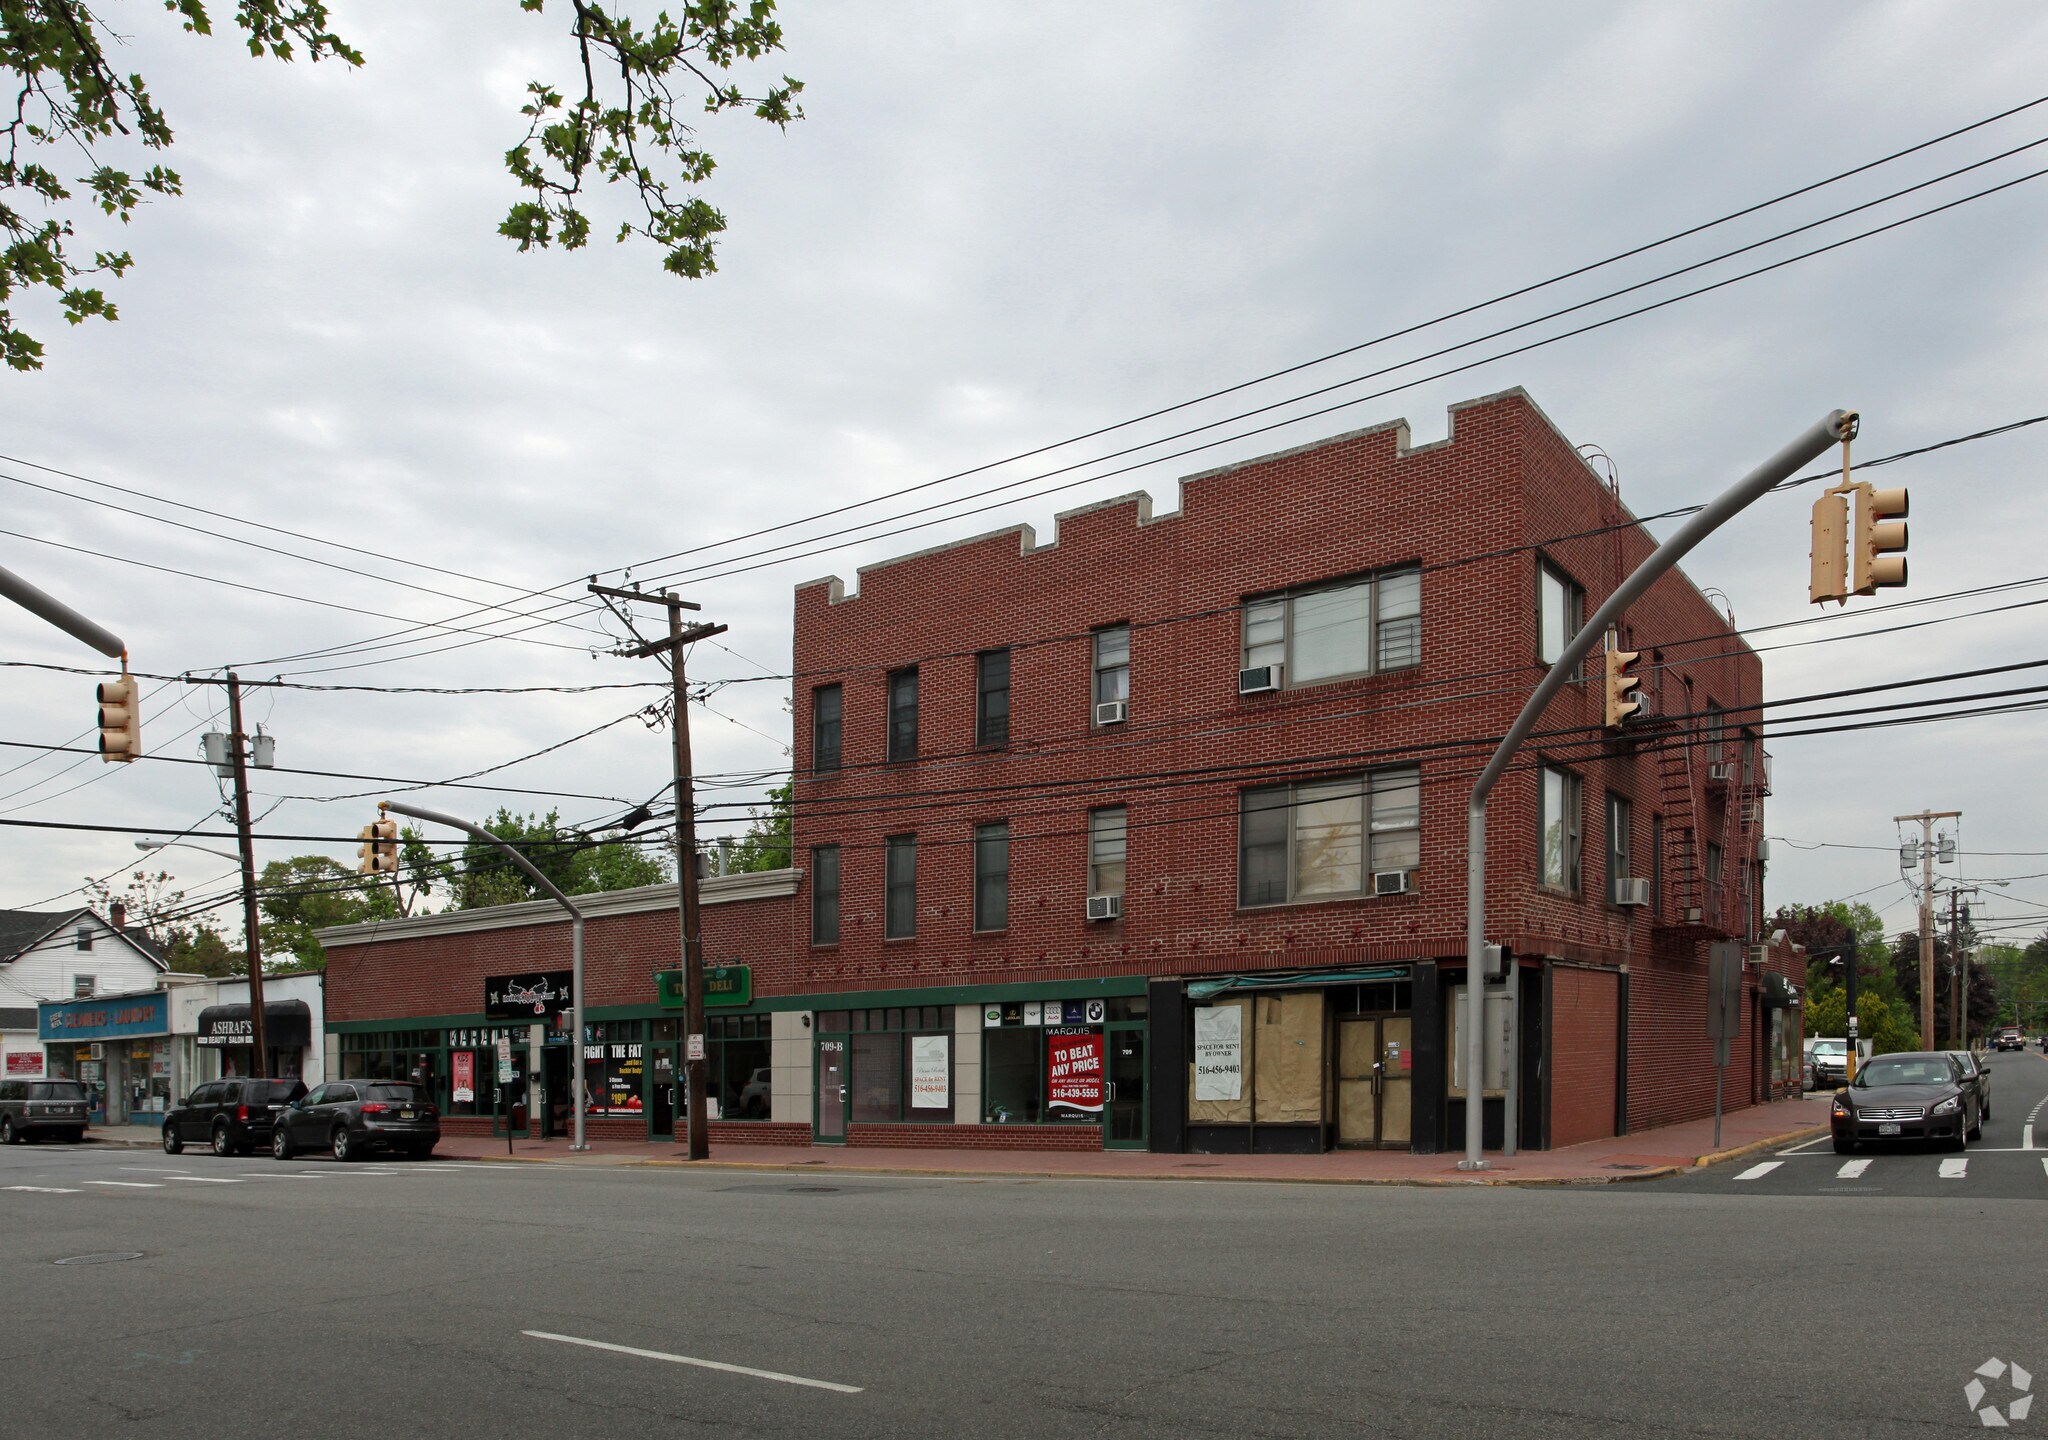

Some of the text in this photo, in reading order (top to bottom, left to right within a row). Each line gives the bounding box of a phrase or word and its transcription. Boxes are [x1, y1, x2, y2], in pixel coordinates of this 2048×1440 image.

[710, 980, 732, 992] DELI
[64, 1006, 155, 1028] CLEANERS LAUNDRY
[212, 1020, 252, 1034] ASHRAF'S
[584, 1044, 642, 1059] FIGHT THE FAT
[821, 1042, 843, 1051] 709-B
[1054, 1045, 1093, 1062] TO BEAT
[1052, 1057, 1099, 1077] ANY PRICE
[1198, 1065, 1240, 1074] 516-456-9403
[1053, 1089, 1098, 1098] 516-439-5555
